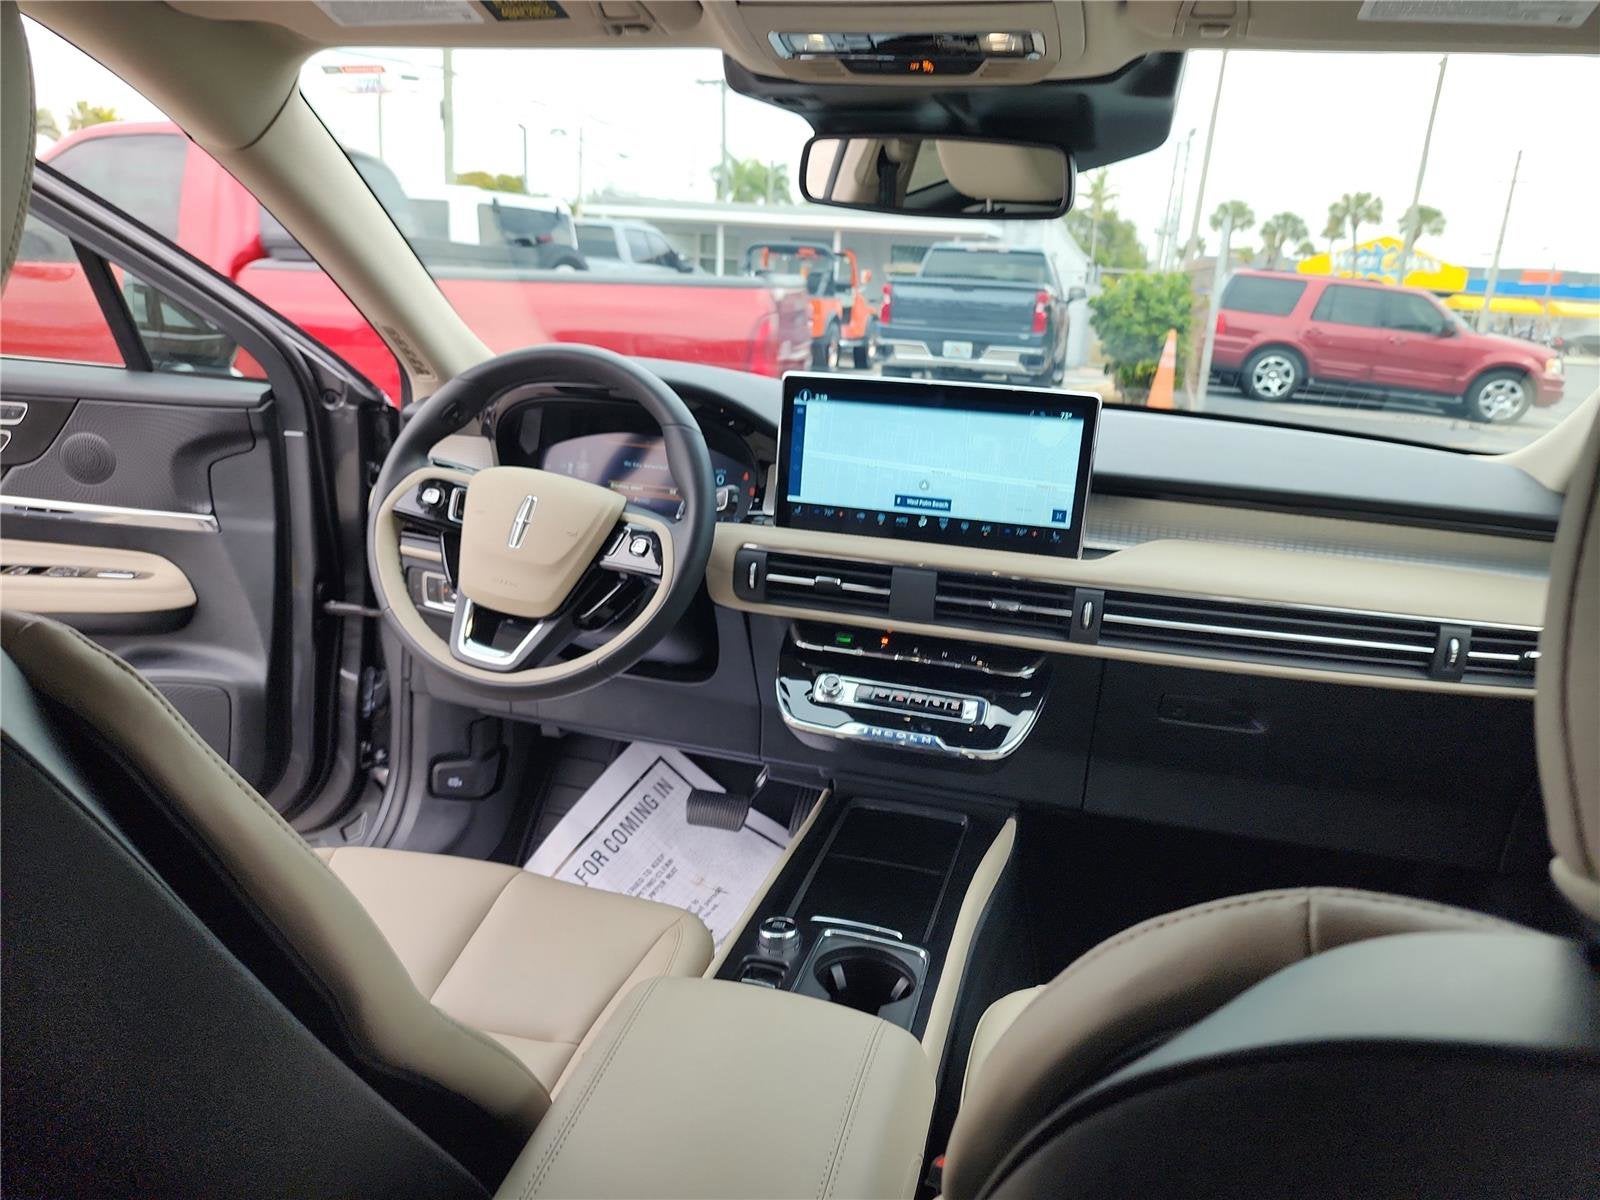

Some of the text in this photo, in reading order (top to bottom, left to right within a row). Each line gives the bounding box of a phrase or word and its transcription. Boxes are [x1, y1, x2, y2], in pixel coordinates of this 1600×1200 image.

[574, 776, 675, 886] FOR COMING IN
